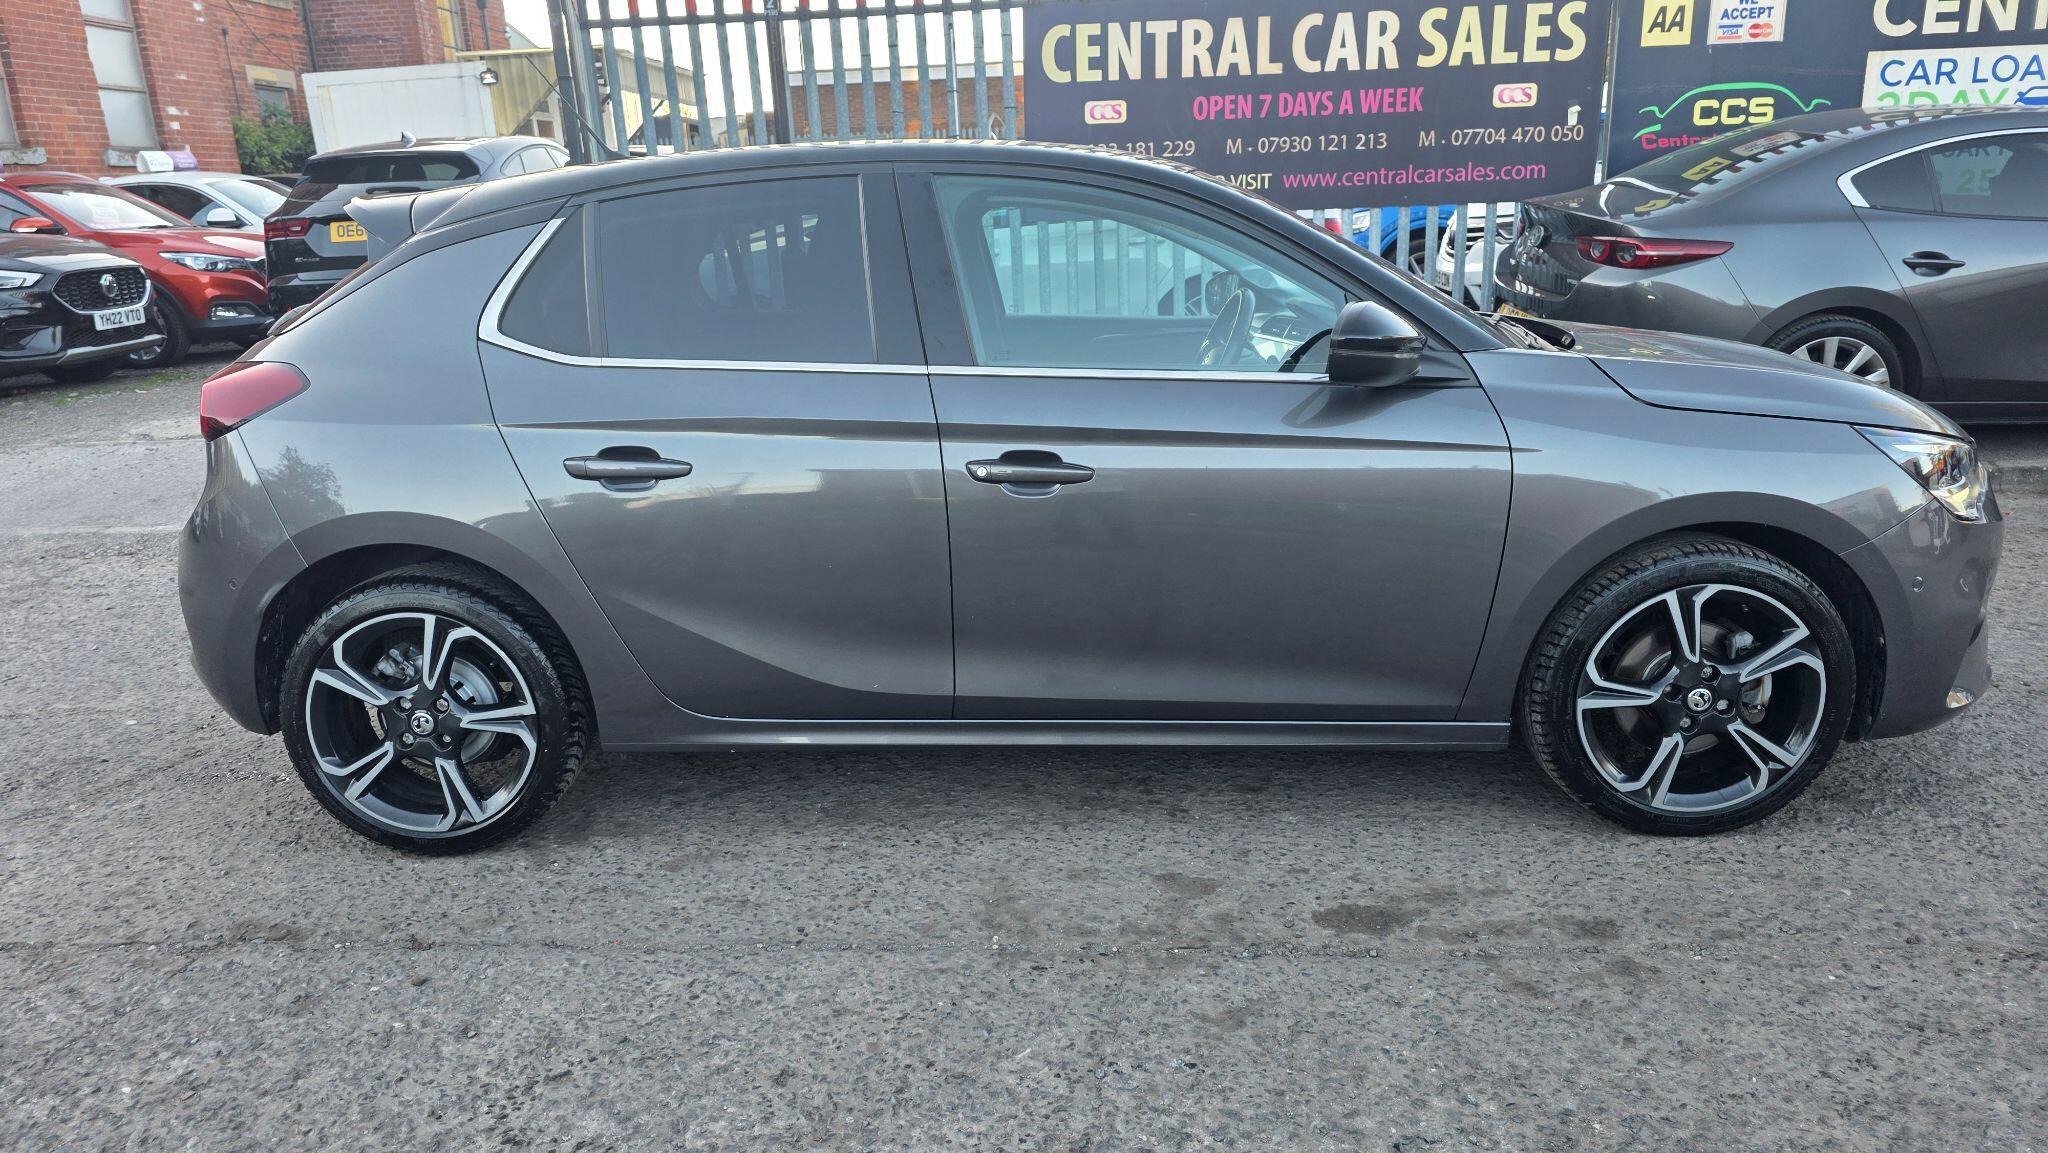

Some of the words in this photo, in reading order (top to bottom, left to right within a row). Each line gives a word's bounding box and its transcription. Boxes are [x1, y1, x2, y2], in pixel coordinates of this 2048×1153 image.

[1647, 5, 1685, 33] AA
[1720, 6, 1774, 20] ACCEPT
[1041, 16, 1283, 83] CENTRAL
[1291, 10, 1400, 74] CAR
[1416, 1, 1587, 68] SALES
[1880, 58, 1958, 87] CAR
[1193, 95, 1252, 121] OPEN
[1259, 94, 1272, 118] 7
[1278, 91, 1334, 118] DAYS
[1338, 90, 1353, 115] A
[1360, 86, 1424, 114] WEEK
[1693, 97, 1775, 126] CCS
[1162, 140, 1195, 157] 229
[1258, 136, 1312, 153] 07930
[1319, 134, 1347, 151] 121
[1355, 132, 1387, 150] 213
[1451, 128, 1506, 146] 07704
[1511, 126, 1546, 143] 470
[1551, 124, 1585, 141] 050
[1229, 173, 1272, 190] VISIT
[1283, 161, 1546, 188] www.centralcarsales.com
[99, 312, 124, 327] YH22
[124, 309, 142, 323] VTO
